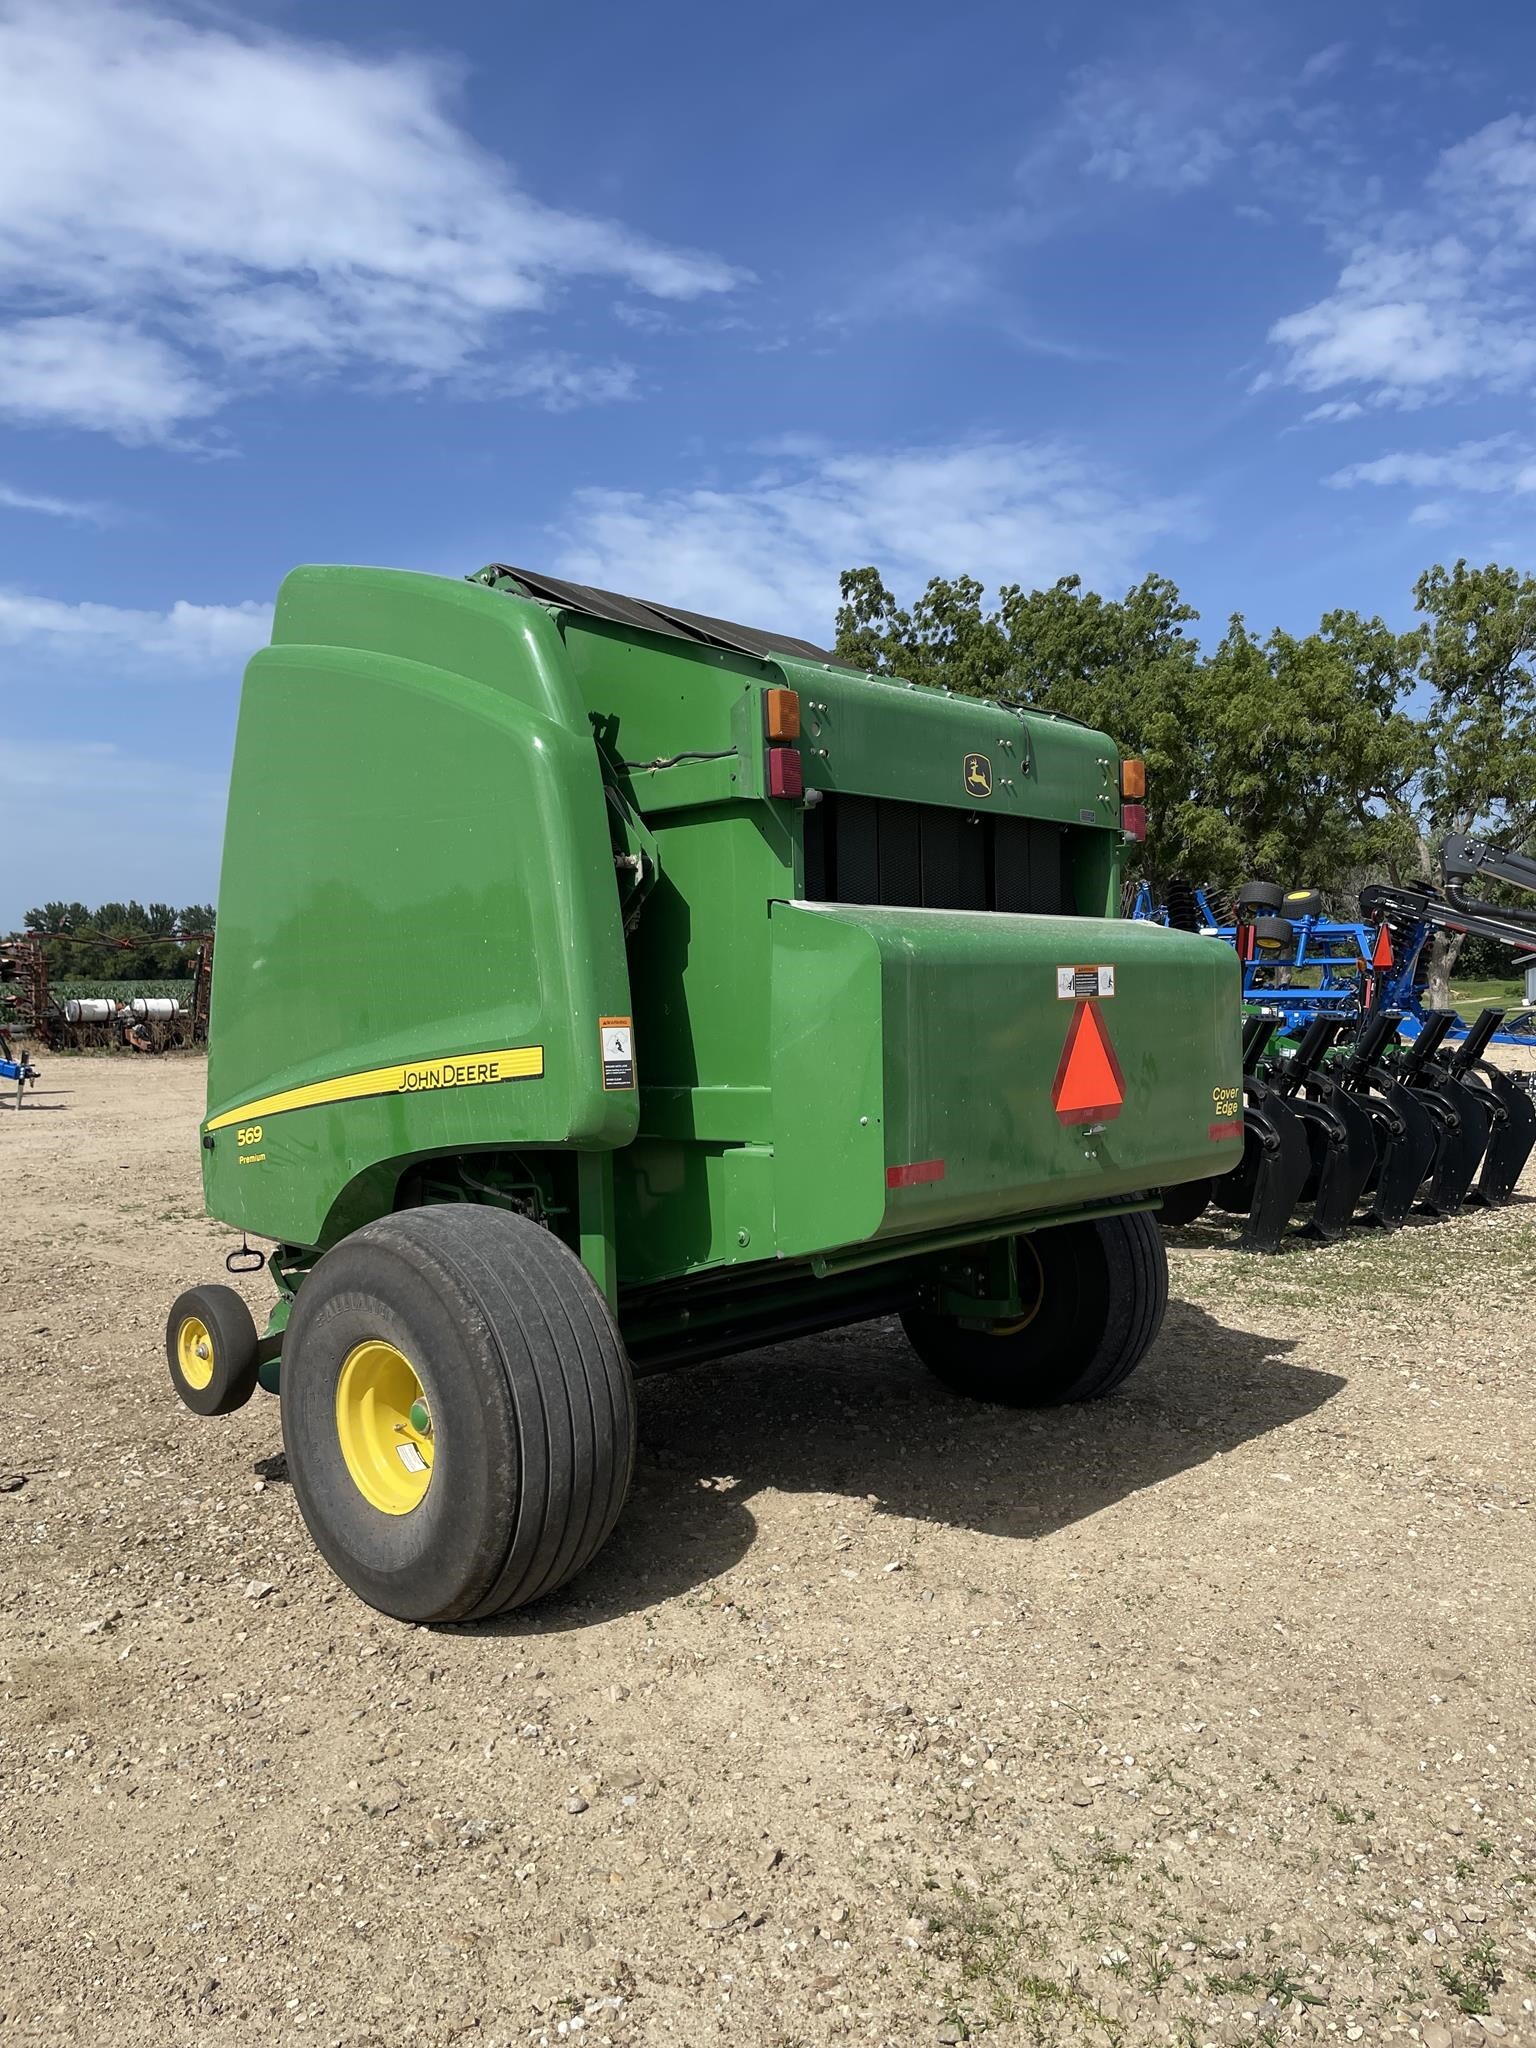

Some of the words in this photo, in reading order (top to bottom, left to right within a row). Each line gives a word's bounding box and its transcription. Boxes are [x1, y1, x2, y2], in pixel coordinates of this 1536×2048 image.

[399, 1069, 440, 1090] JOHN
[443, 1062, 499, 1084] DEERE
[1212, 1087, 1239, 1101] Cover
[1216, 1101, 1238, 1116] Edge
[237, 1125, 263, 1147] 569
[239, 1153, 266, 1165] Premium
